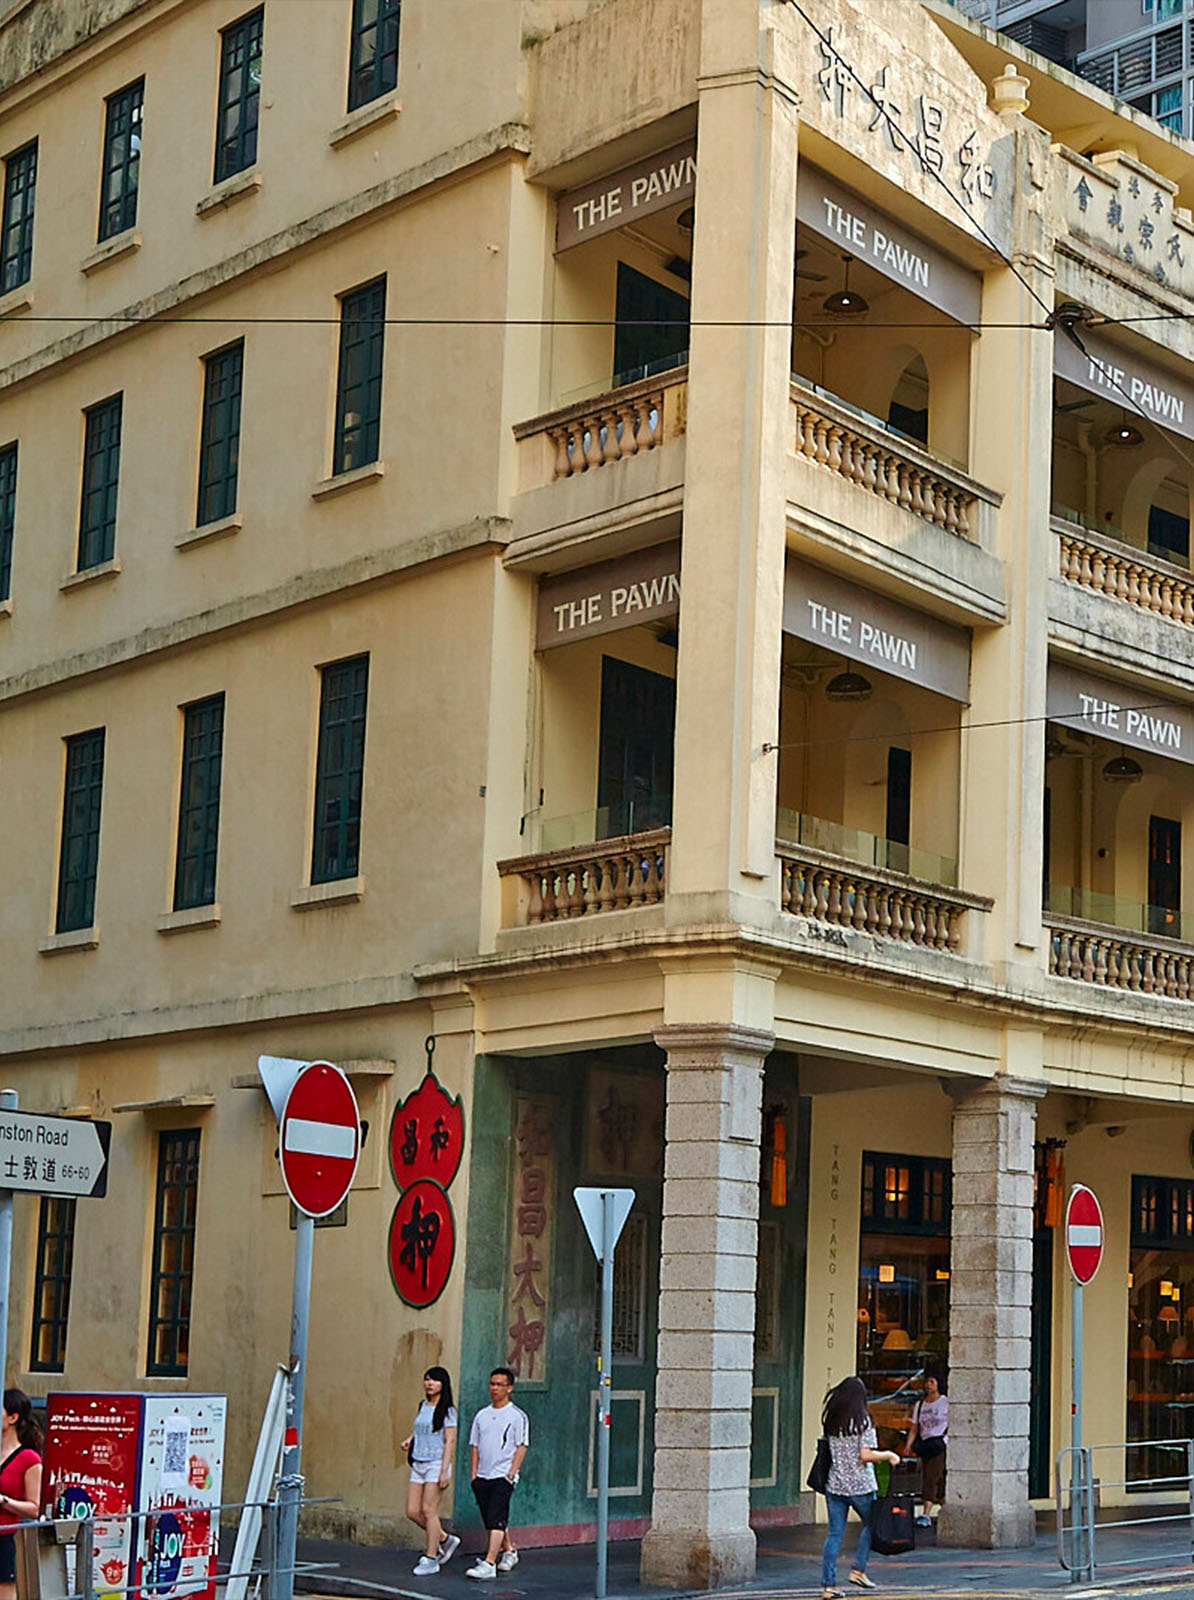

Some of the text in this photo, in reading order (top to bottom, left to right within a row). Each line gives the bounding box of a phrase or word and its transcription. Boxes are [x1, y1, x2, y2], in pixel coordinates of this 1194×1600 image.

[573, 188, 622, 231] THE
[823, 197, 929, 288] THE PAWN
[1086, 355, 1184, 423] THE PAWN
[554, 593, 602, 632] THE
[808, 600, 916, 669] THE PAWN
[1079, 693, 1181, 749] THE PAWN
[36, 1125, 69, 1146] Road
[4, 1154, 56, 1182] 士敦道
[830, 1144, 840, 1200] TANG
[400, 1196, 441, 1290] 押
[828, 1218, 838, 1275] TANG
[826, 1292, 836, 1349] TANG
[66, 1501, 97, 1519] JOY
[160, 1532, 186, 1559] JOY
